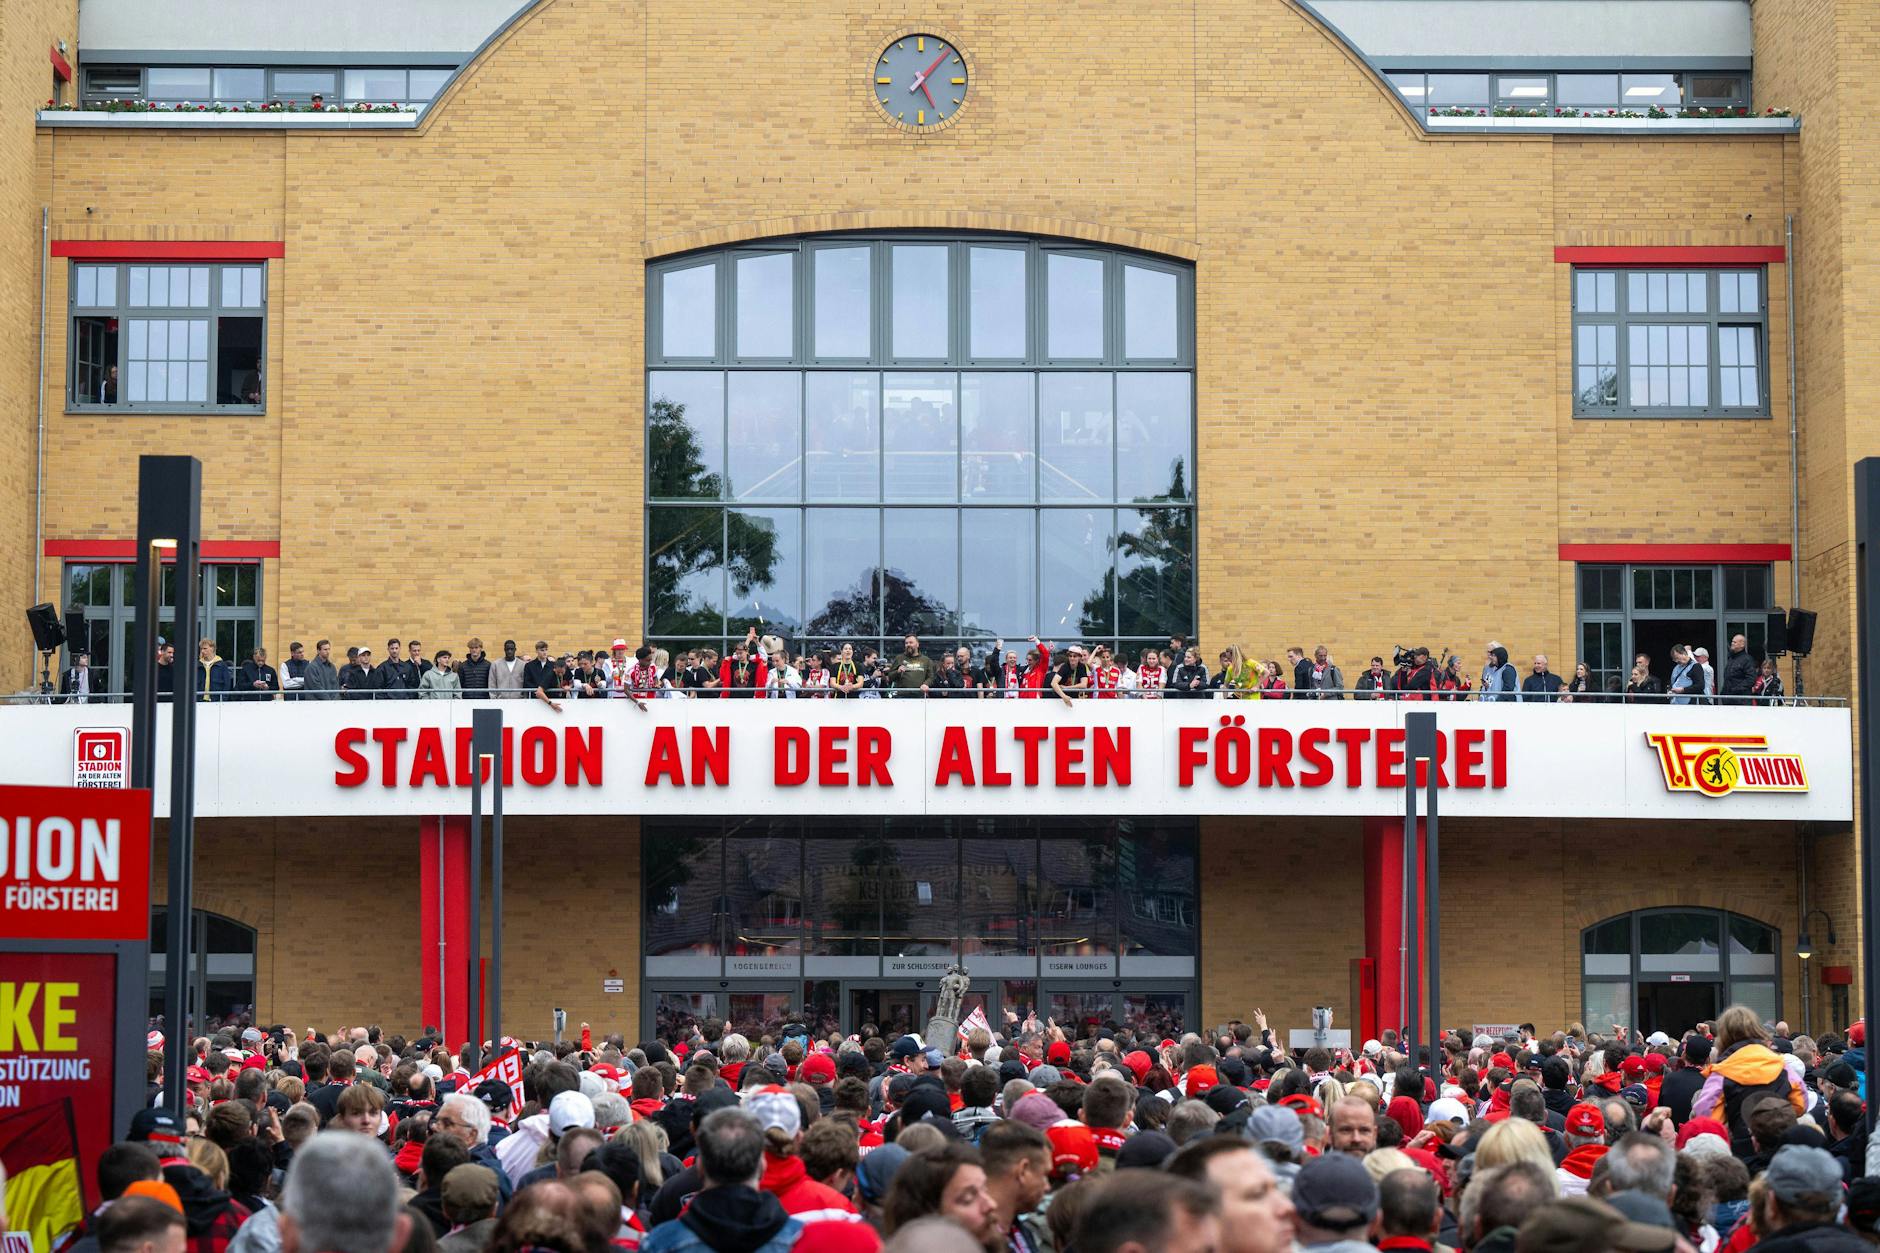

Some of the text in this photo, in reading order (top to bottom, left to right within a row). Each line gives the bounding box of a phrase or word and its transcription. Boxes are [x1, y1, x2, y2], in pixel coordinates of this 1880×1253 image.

[335, 715, 1507, 788] STADION AN DER ALTEN FÖRSTEREI
[78, 762, 122, 772] STADION
[1739, 757, 1804, 786] UNION
[0, 816, 121, 882] ION
[5, 882, 119, 911] FÖRSTEREI
